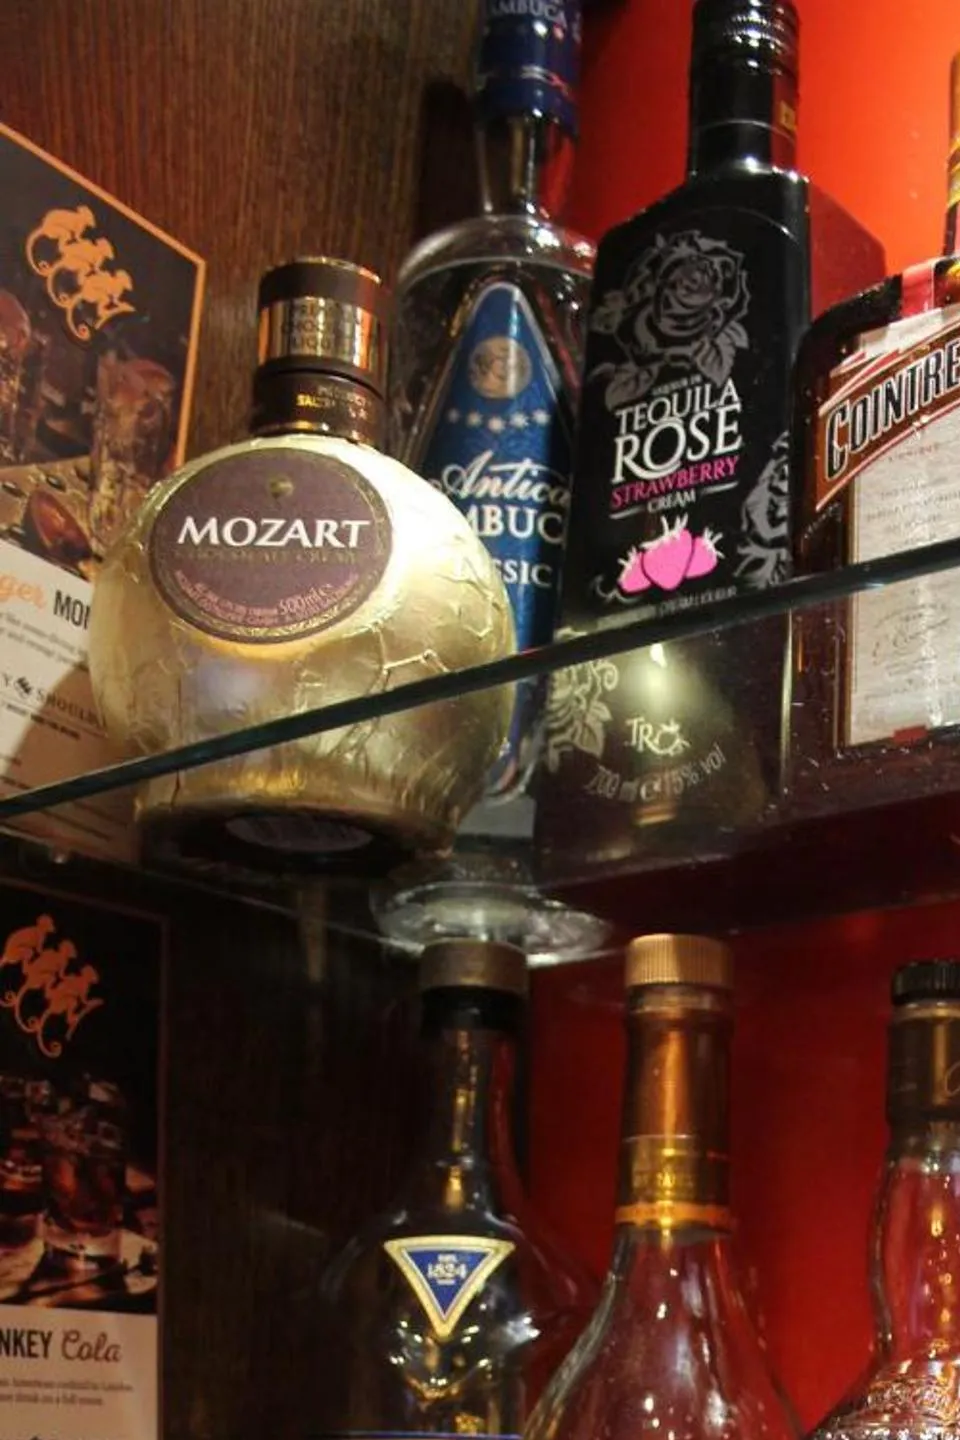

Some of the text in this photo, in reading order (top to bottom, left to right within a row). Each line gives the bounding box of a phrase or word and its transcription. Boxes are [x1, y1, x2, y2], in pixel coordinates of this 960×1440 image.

[615, 377, 742, 435] TEQUILA
[611, 403, 743, 484] ROSE
[441, 450, 572, 505] Antica
[611, 455, 739, 508] STRAWBERRY
[647, 489, 697, 512] CREAM
[177, 516, 371, 549] MOZART
[0, 1329, 122, 1363] NKEY Cola
